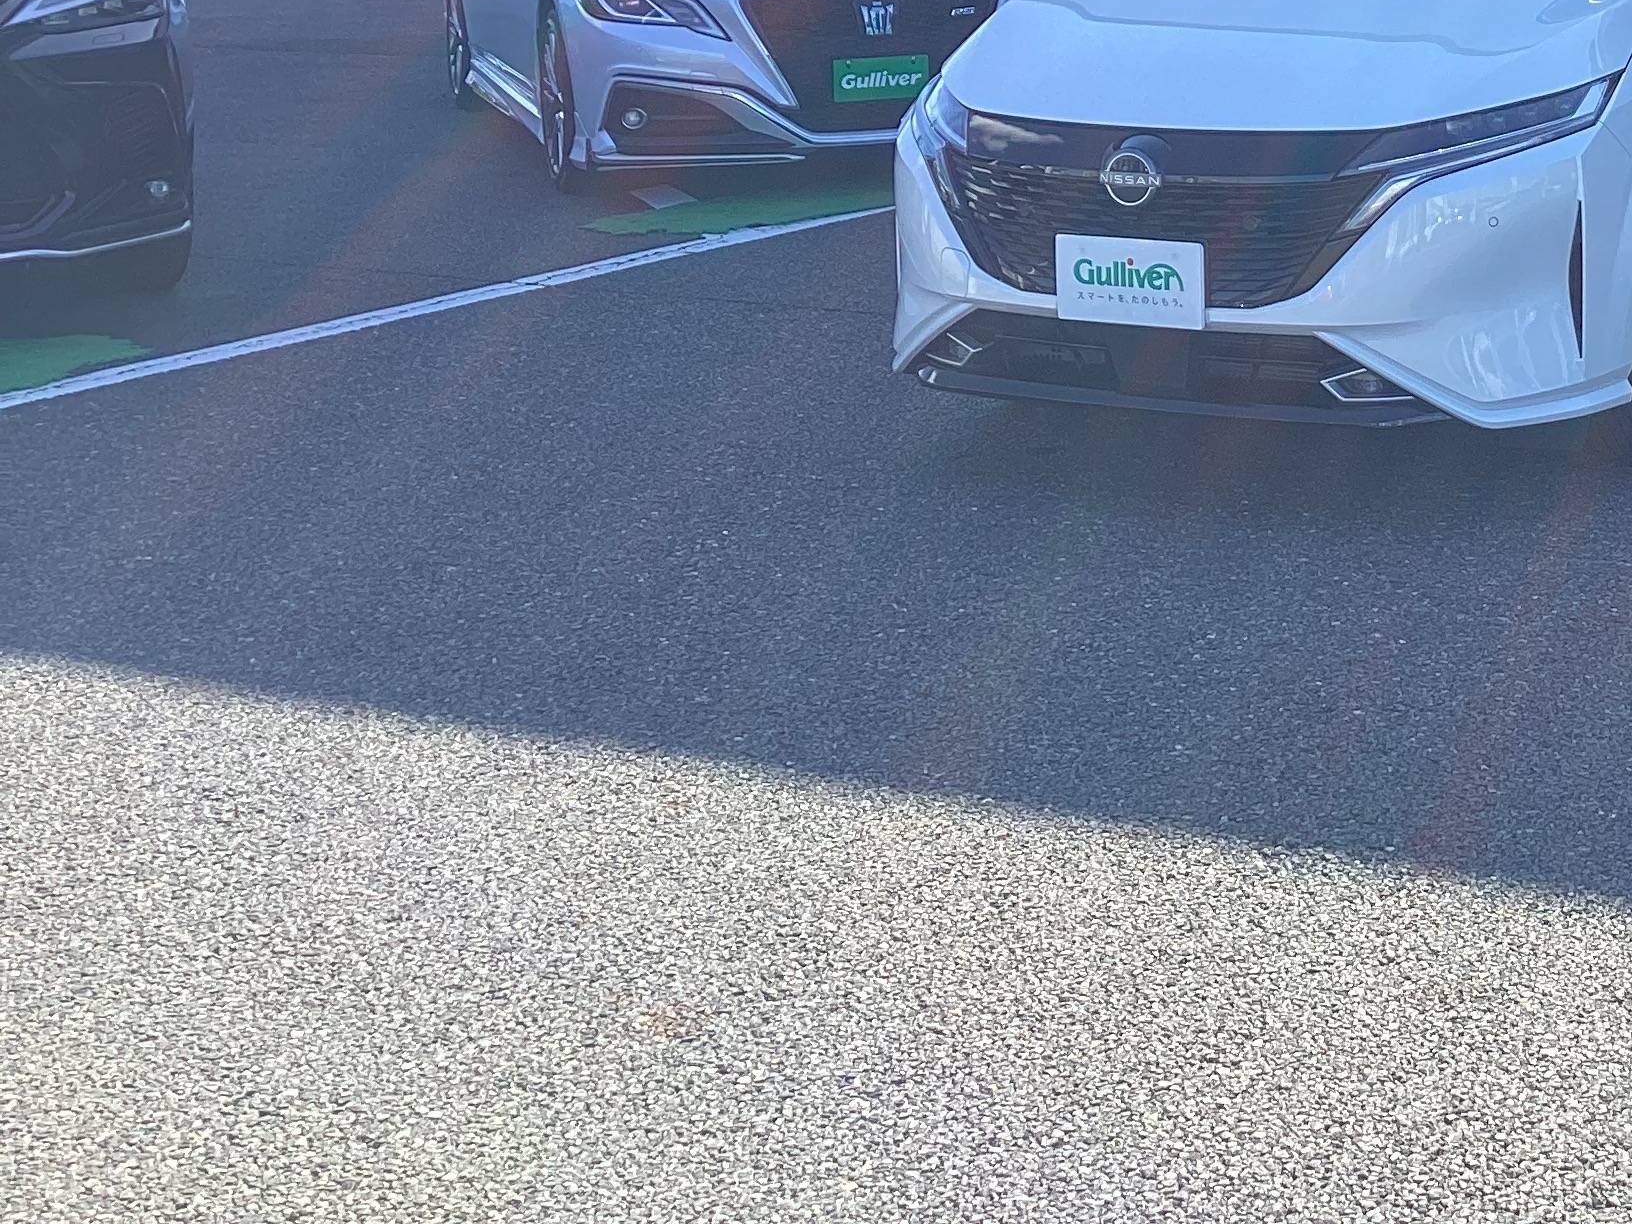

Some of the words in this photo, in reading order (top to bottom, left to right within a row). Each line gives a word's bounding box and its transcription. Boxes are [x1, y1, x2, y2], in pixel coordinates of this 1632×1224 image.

[841, 70, 922, 90] Gulliver
[1100, 173, 1161, 186] NISSAN
[1073, 257, 1185, 292] Gulliver
[1077, 292, 1184, 308] スマートを、たのしもう。
